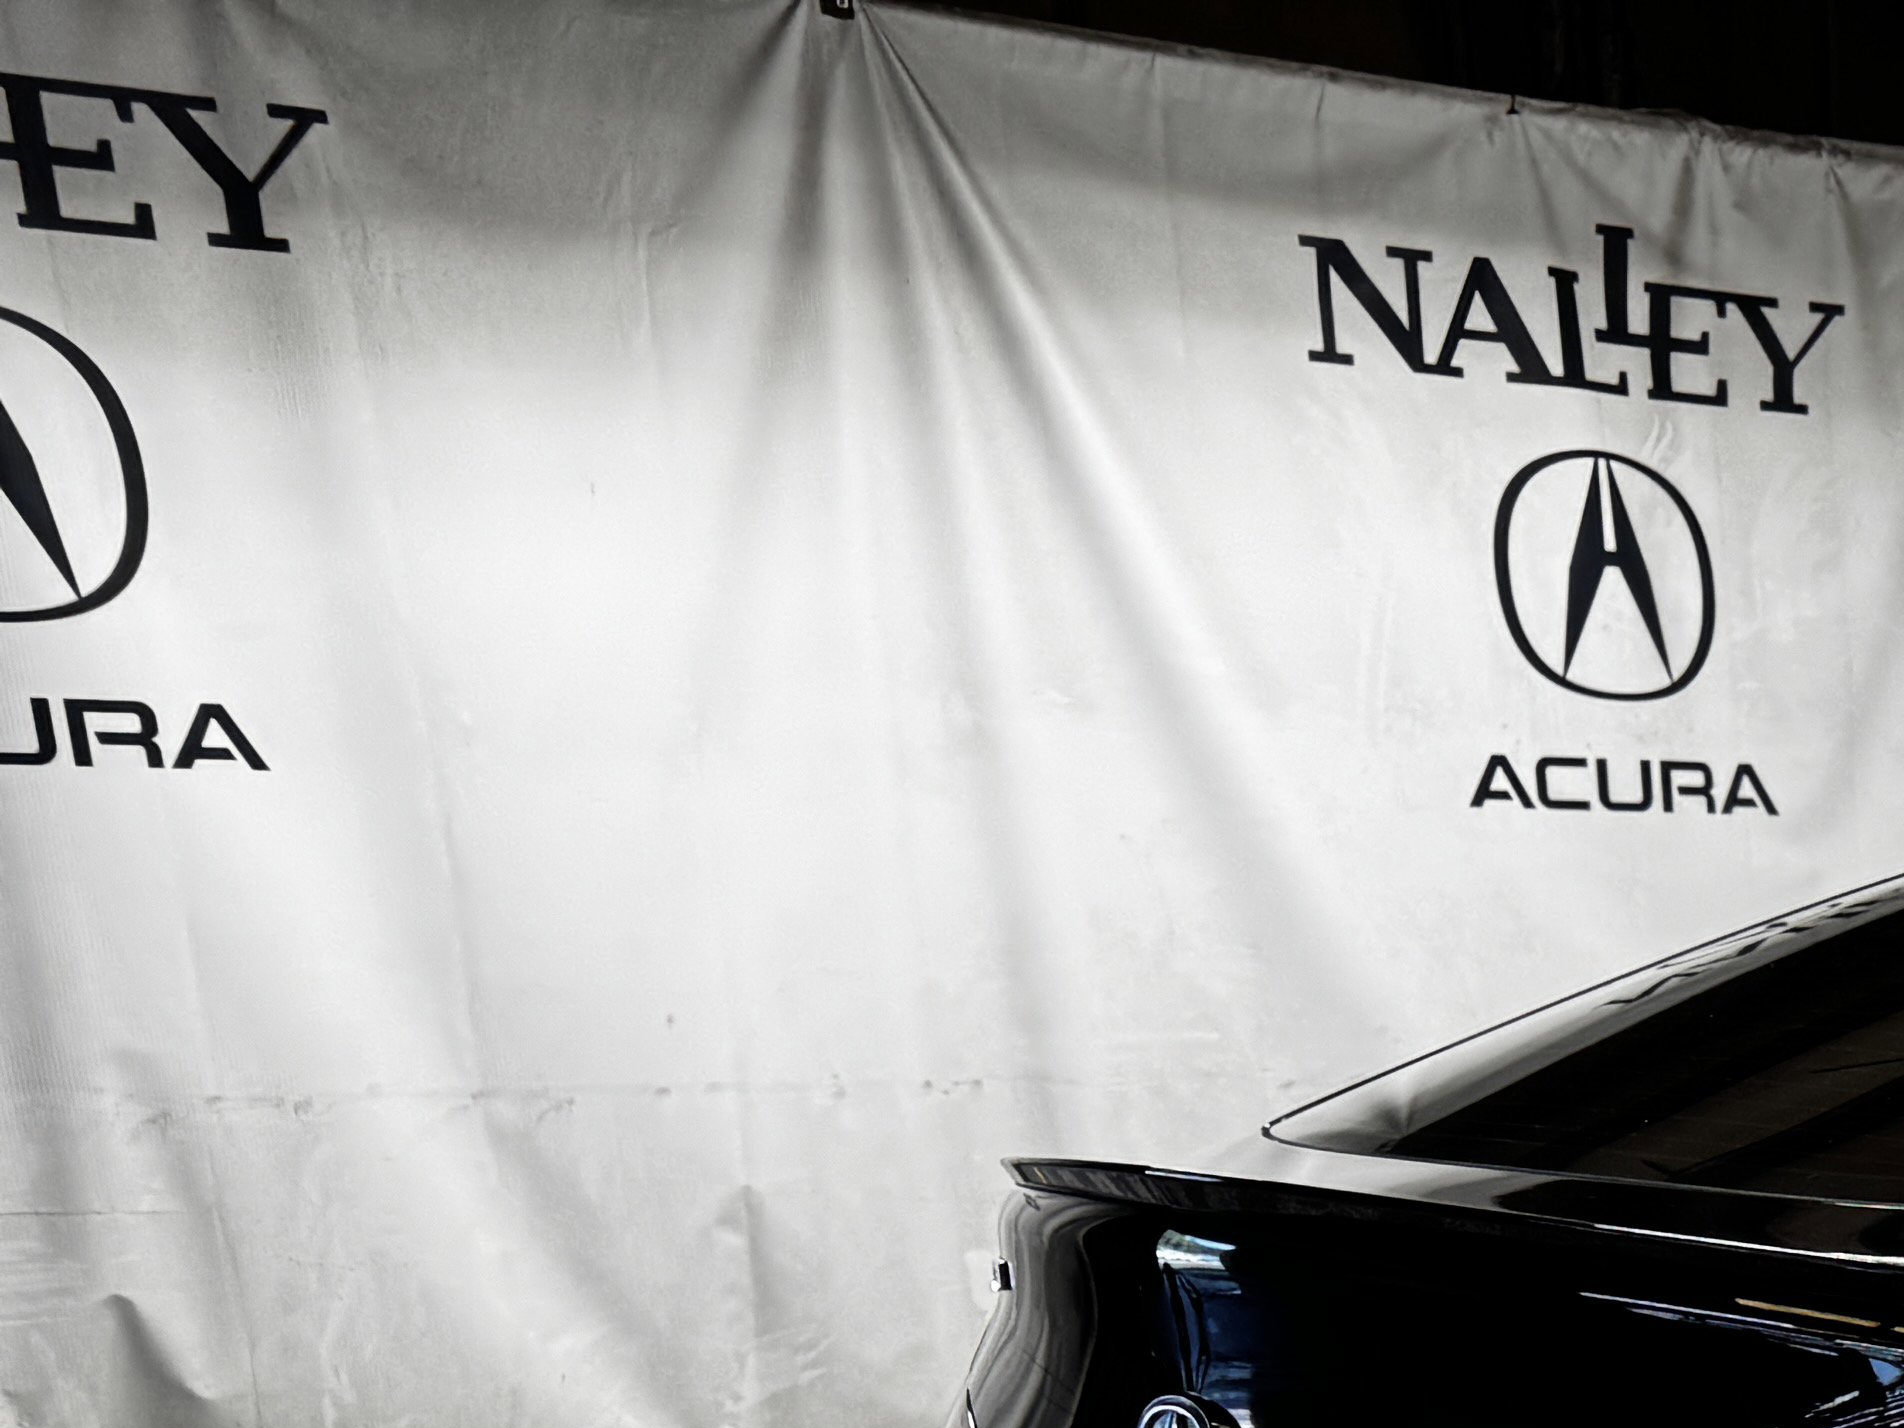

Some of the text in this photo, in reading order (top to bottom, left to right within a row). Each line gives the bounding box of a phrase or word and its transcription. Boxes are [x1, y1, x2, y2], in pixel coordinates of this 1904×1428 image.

[0, 72, 329, 254] EY
[1297, 222, 1846, 416] NALLEY
[1468, 753, 1781, 817] ACURA
